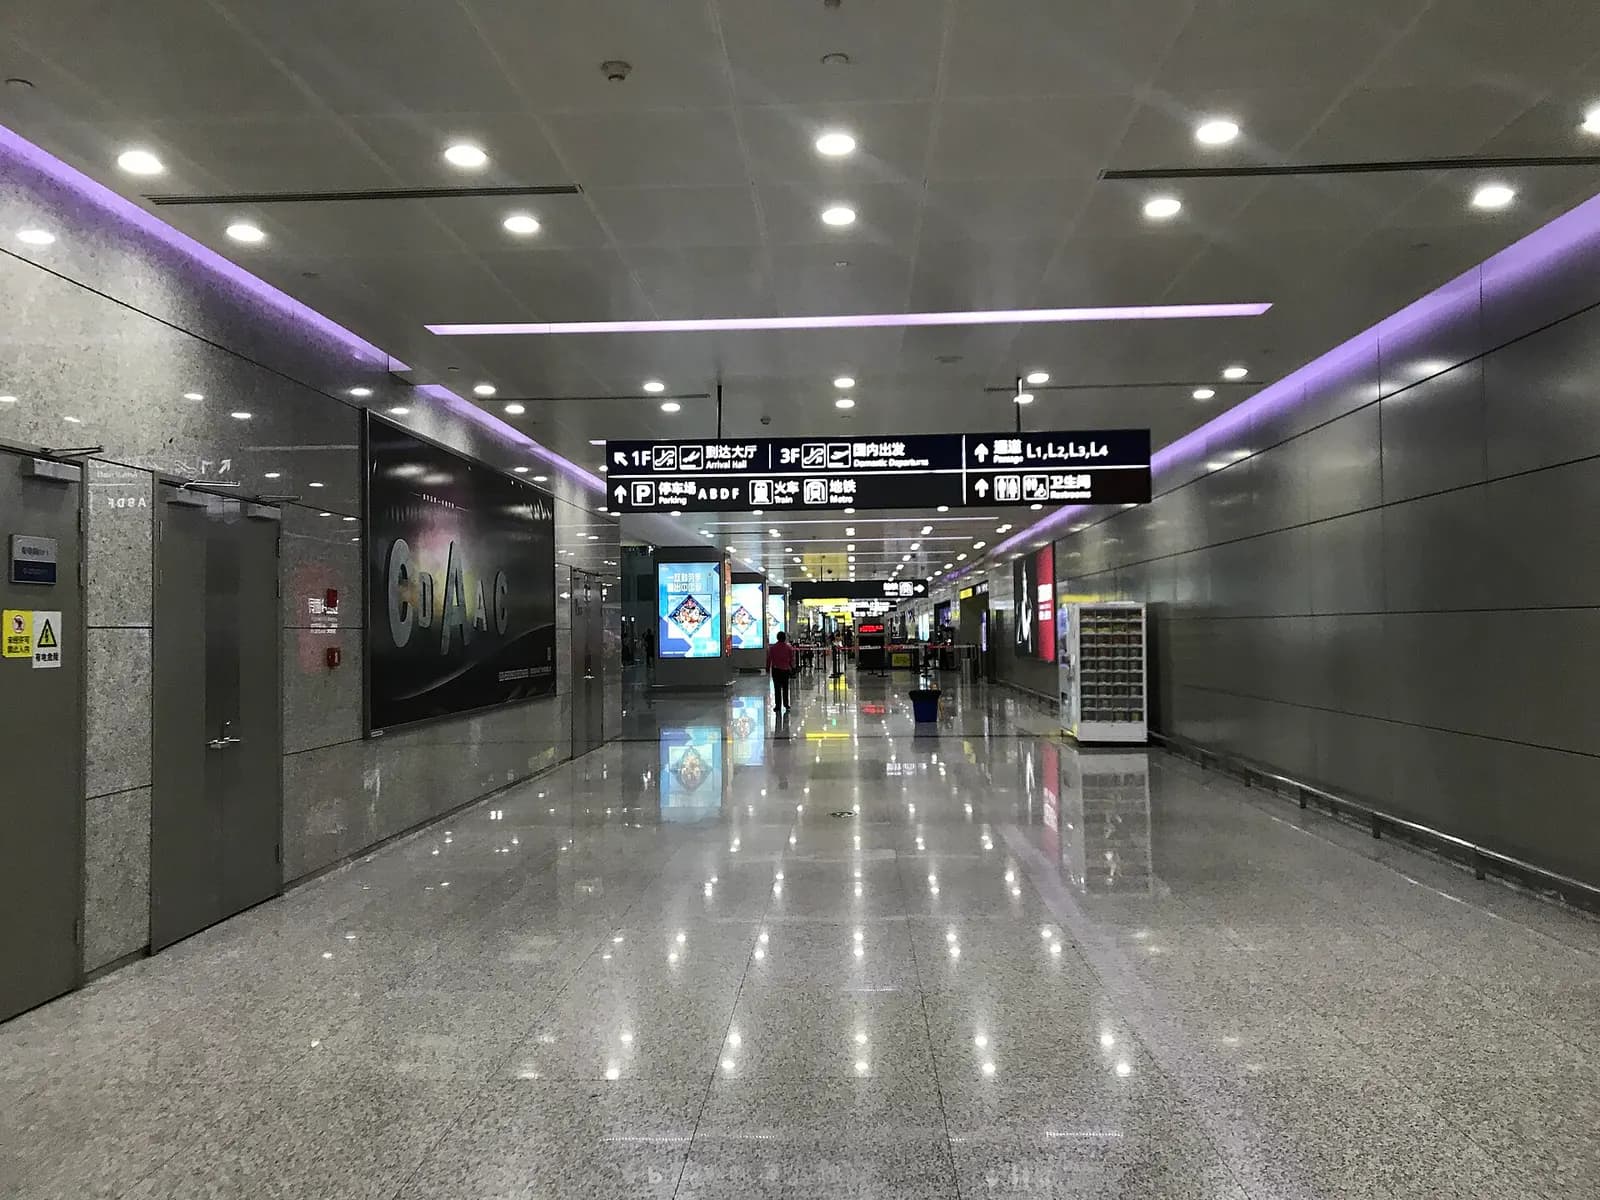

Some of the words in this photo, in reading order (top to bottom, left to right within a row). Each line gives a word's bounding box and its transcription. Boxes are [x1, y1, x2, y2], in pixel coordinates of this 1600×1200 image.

[705, 445, 757, 459] 到达大厅
[780, 448, 800, 464] 3F
[853, 442, 905, 457] 国内出发
[632, 450, 651, 466] 1F
[705, 460, 731, 469] Arrival
[732, 460, 747, 469] Hall
[658, 481, 696, 495] 停车场
[774, 480, 799, 494] 火车
[829, 479, 857, 494] 地铁
[1050, 474, 1091, 489] 卫生间
[658, 496, 688, 506] Parking
[774, 496, 793, 504] Train
[830, 495, 853, 504] Metro
